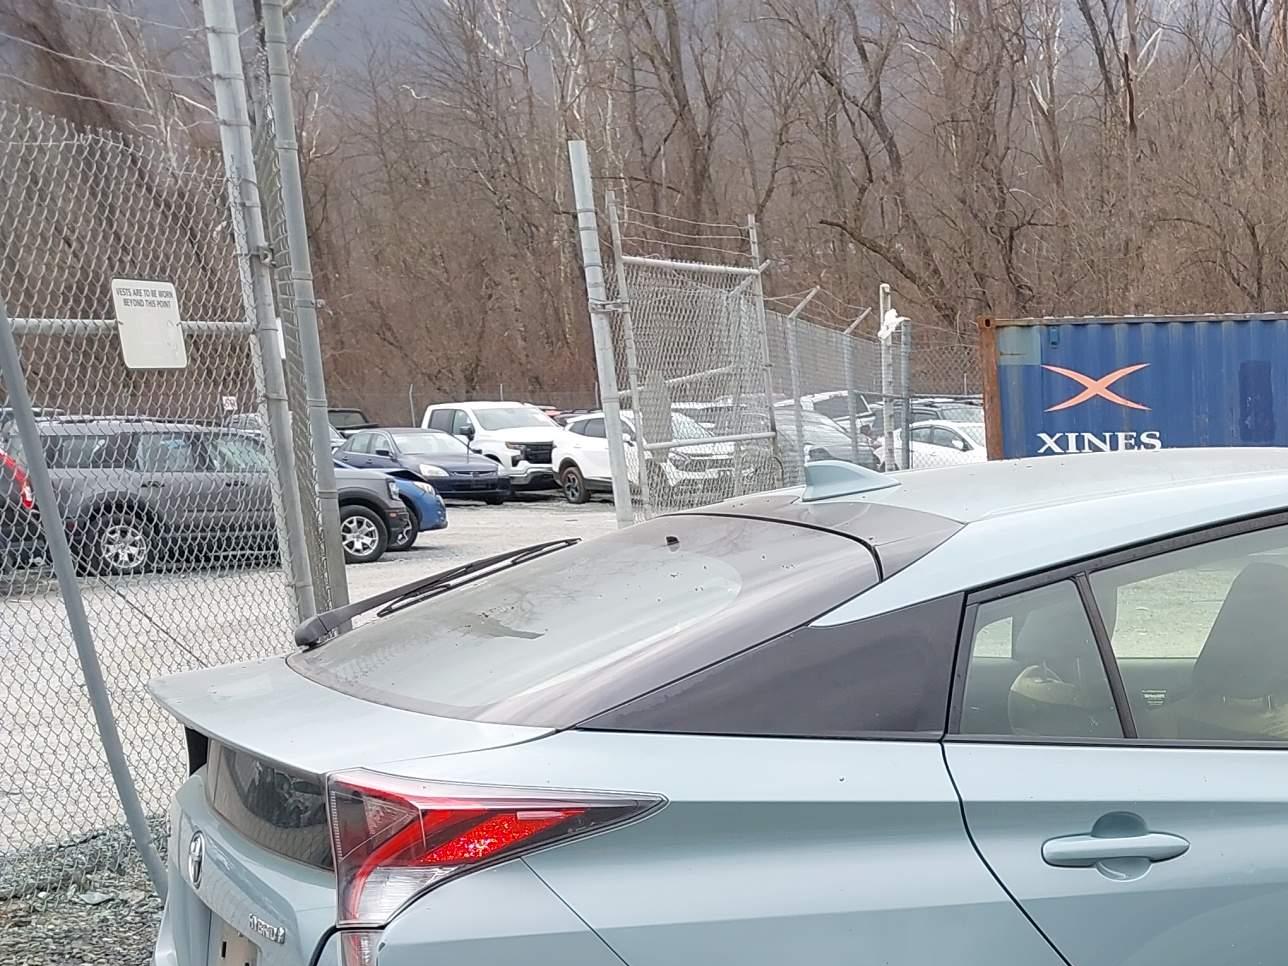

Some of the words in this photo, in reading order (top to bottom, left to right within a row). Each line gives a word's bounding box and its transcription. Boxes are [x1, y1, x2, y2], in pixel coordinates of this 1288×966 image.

[116, 288, 132, 297] VESTS
[132, 288, 142, 297] ARE
[143, 289, 150, 297] TO
[123, 298, 144, 307] BEYOND
[145, 299, 156, 308] THIS
[157, 300, 171, 308] POINT
[1036, 431, 1162, 453] XINES
